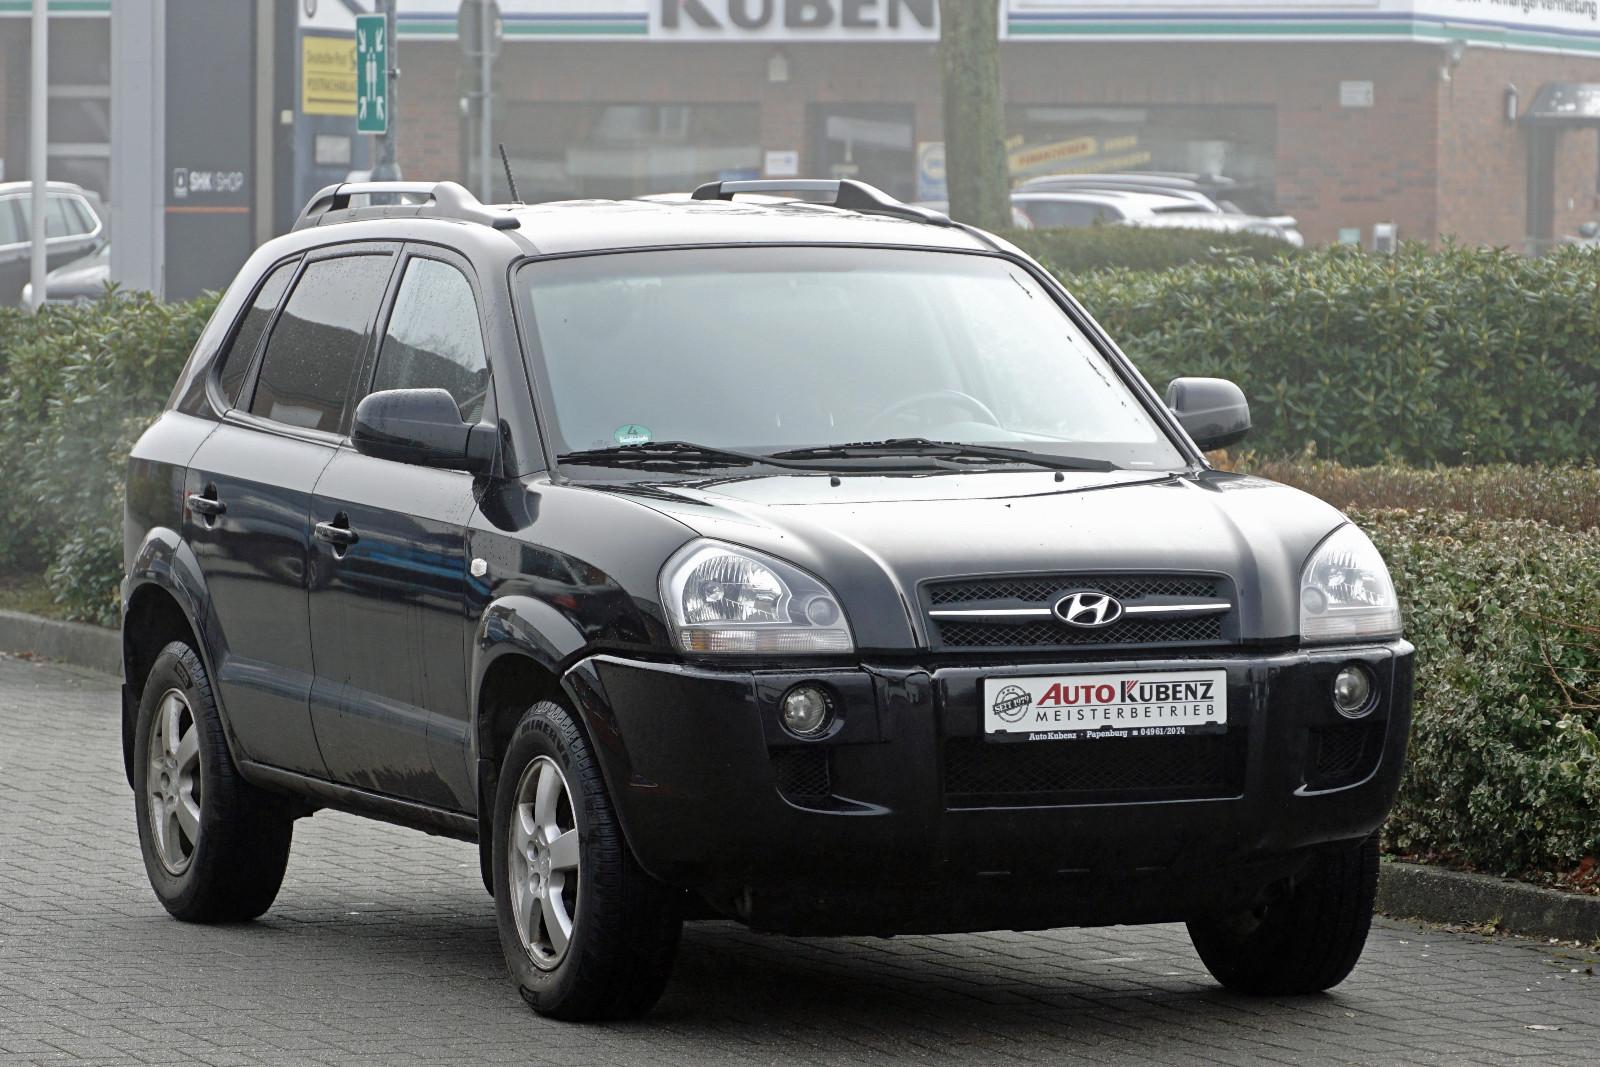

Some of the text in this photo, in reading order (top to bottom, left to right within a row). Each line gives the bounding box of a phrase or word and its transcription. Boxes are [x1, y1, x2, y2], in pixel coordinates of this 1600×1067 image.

[627, 425, 638, 435] 4
[1037, 679, 1214, 706] AUTO KUBENZ
[1035, 704, 1215, 723] MEISTERBETRIEB
[1086, 729, 1129, 739] Papenburg
[1140, 726, 1186, 736] 04961/2074
